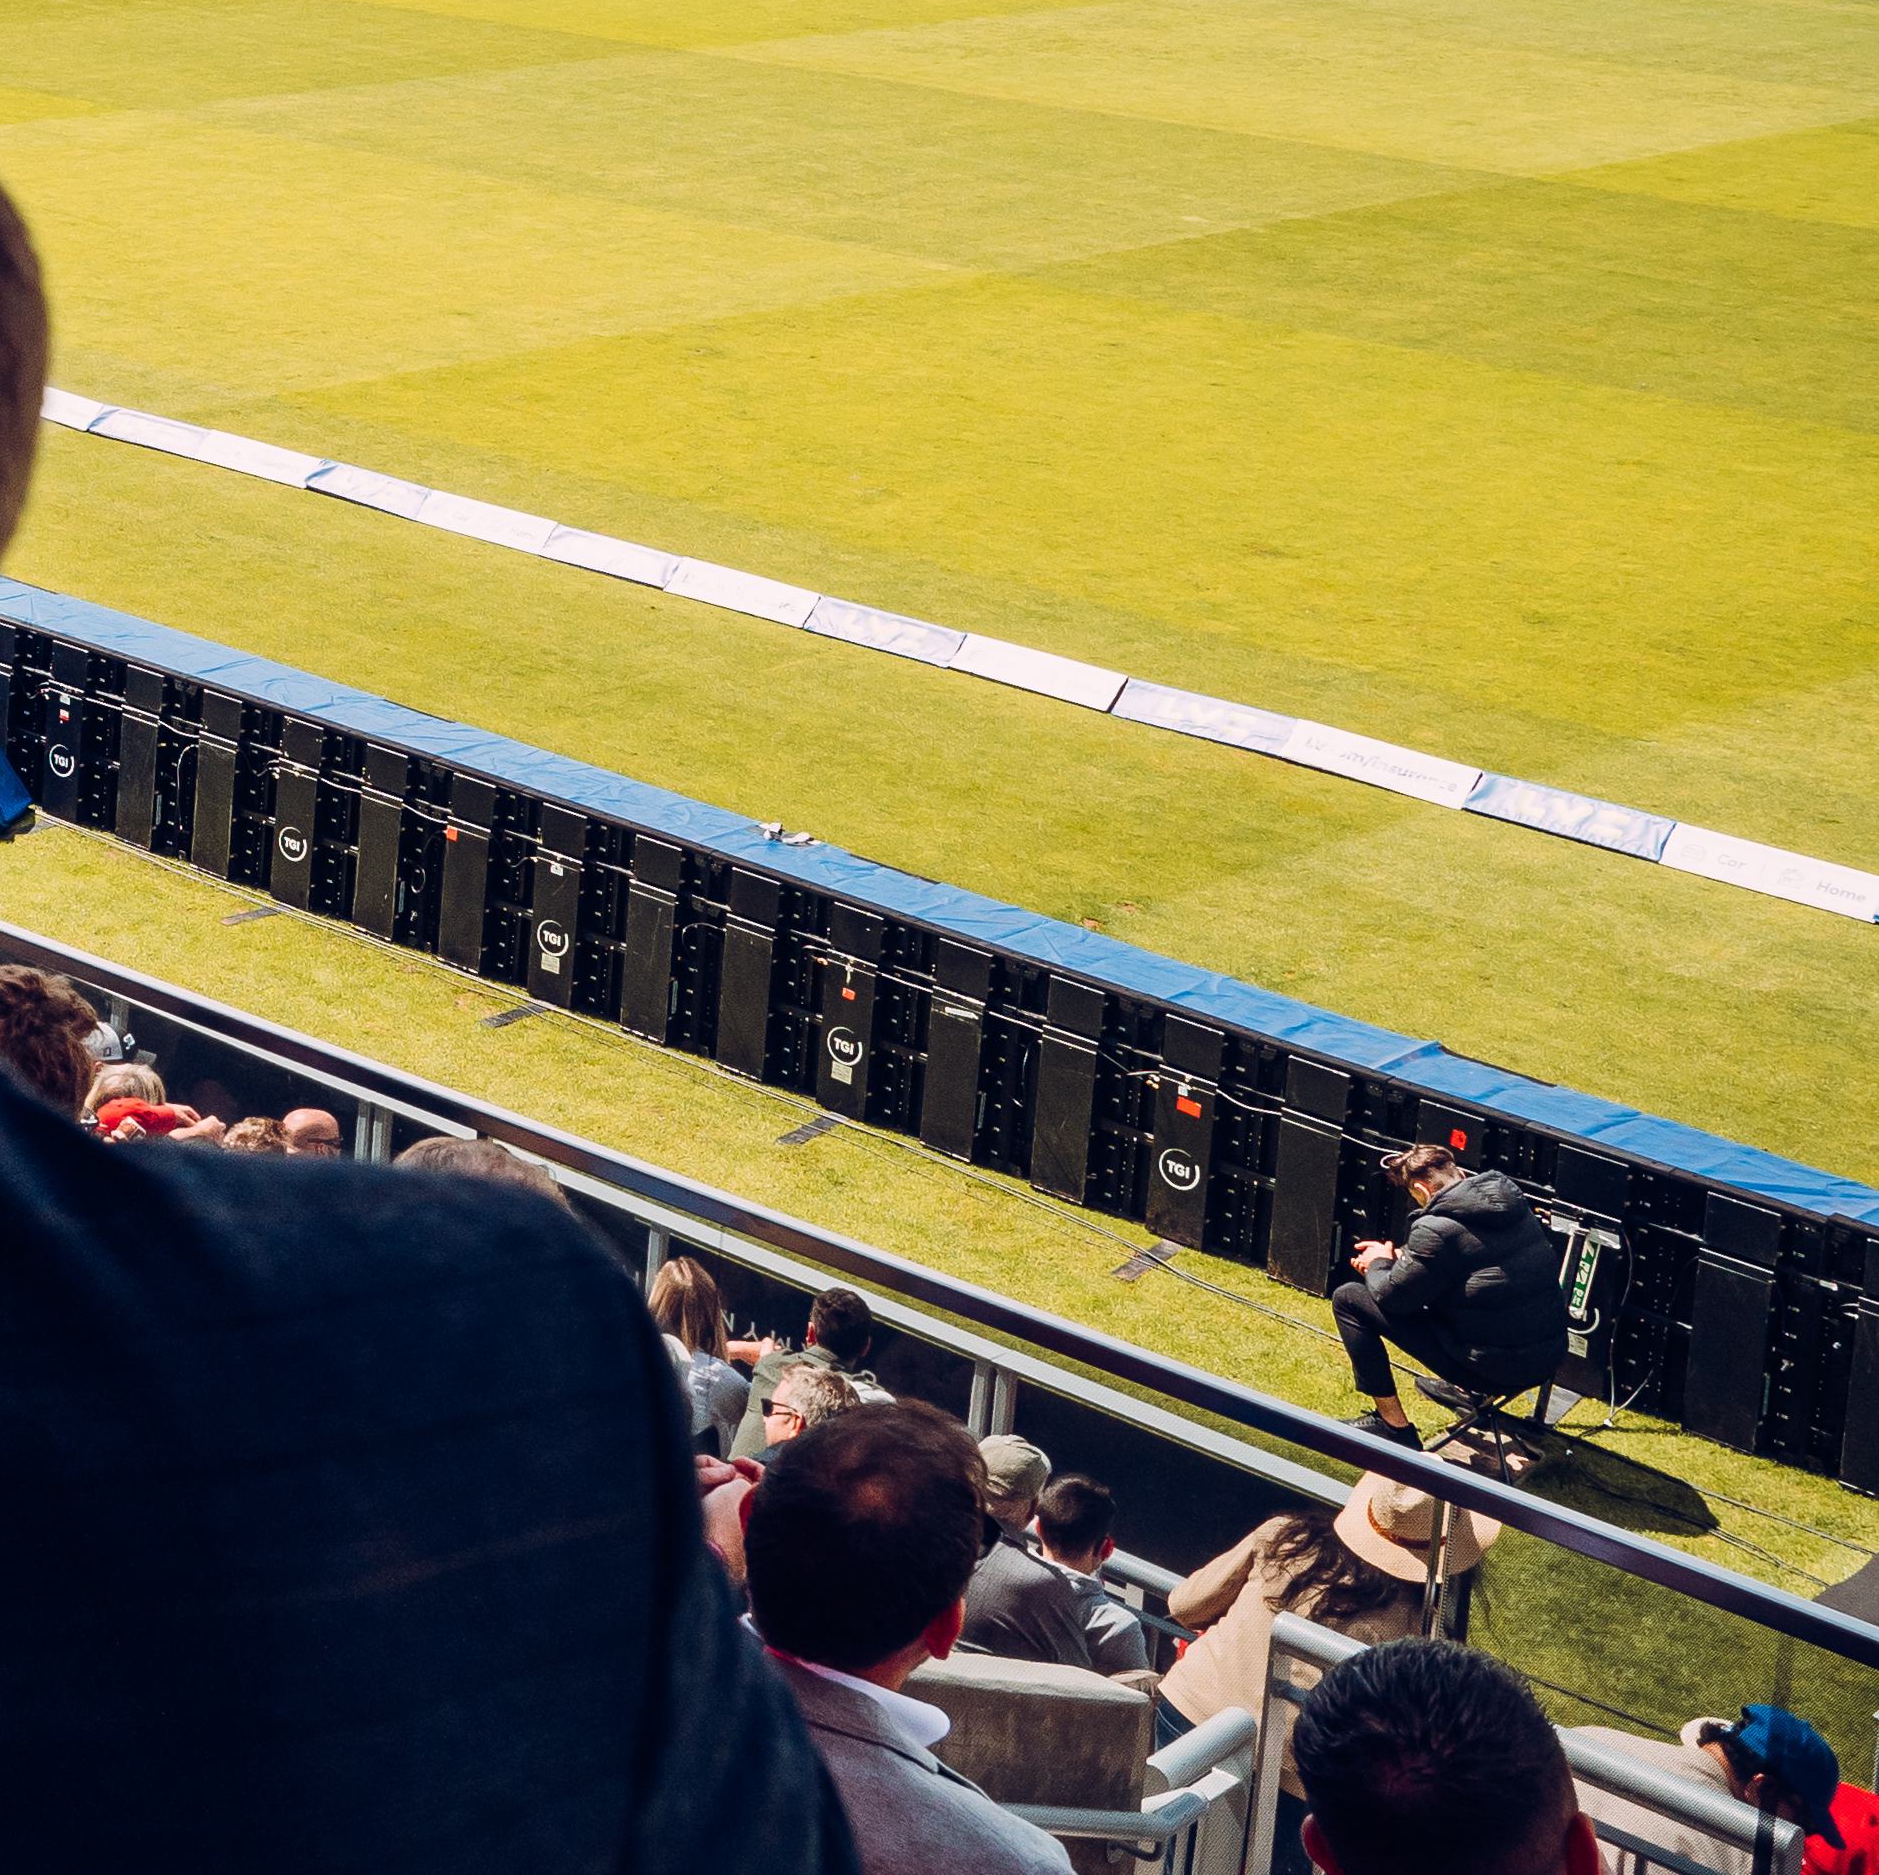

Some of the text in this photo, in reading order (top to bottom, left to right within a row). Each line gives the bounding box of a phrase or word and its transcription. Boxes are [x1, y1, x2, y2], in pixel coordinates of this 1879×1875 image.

[53, 753, 69, 768] TGI
[283, 836, 301, 852] TGI
[1717, 851, 1868, 904] Car Home
[543, 929, 562, 947] TGI
[833, 1036, 855, 1056] TGI
[1166, 1159, 1190, 1180] TGI
